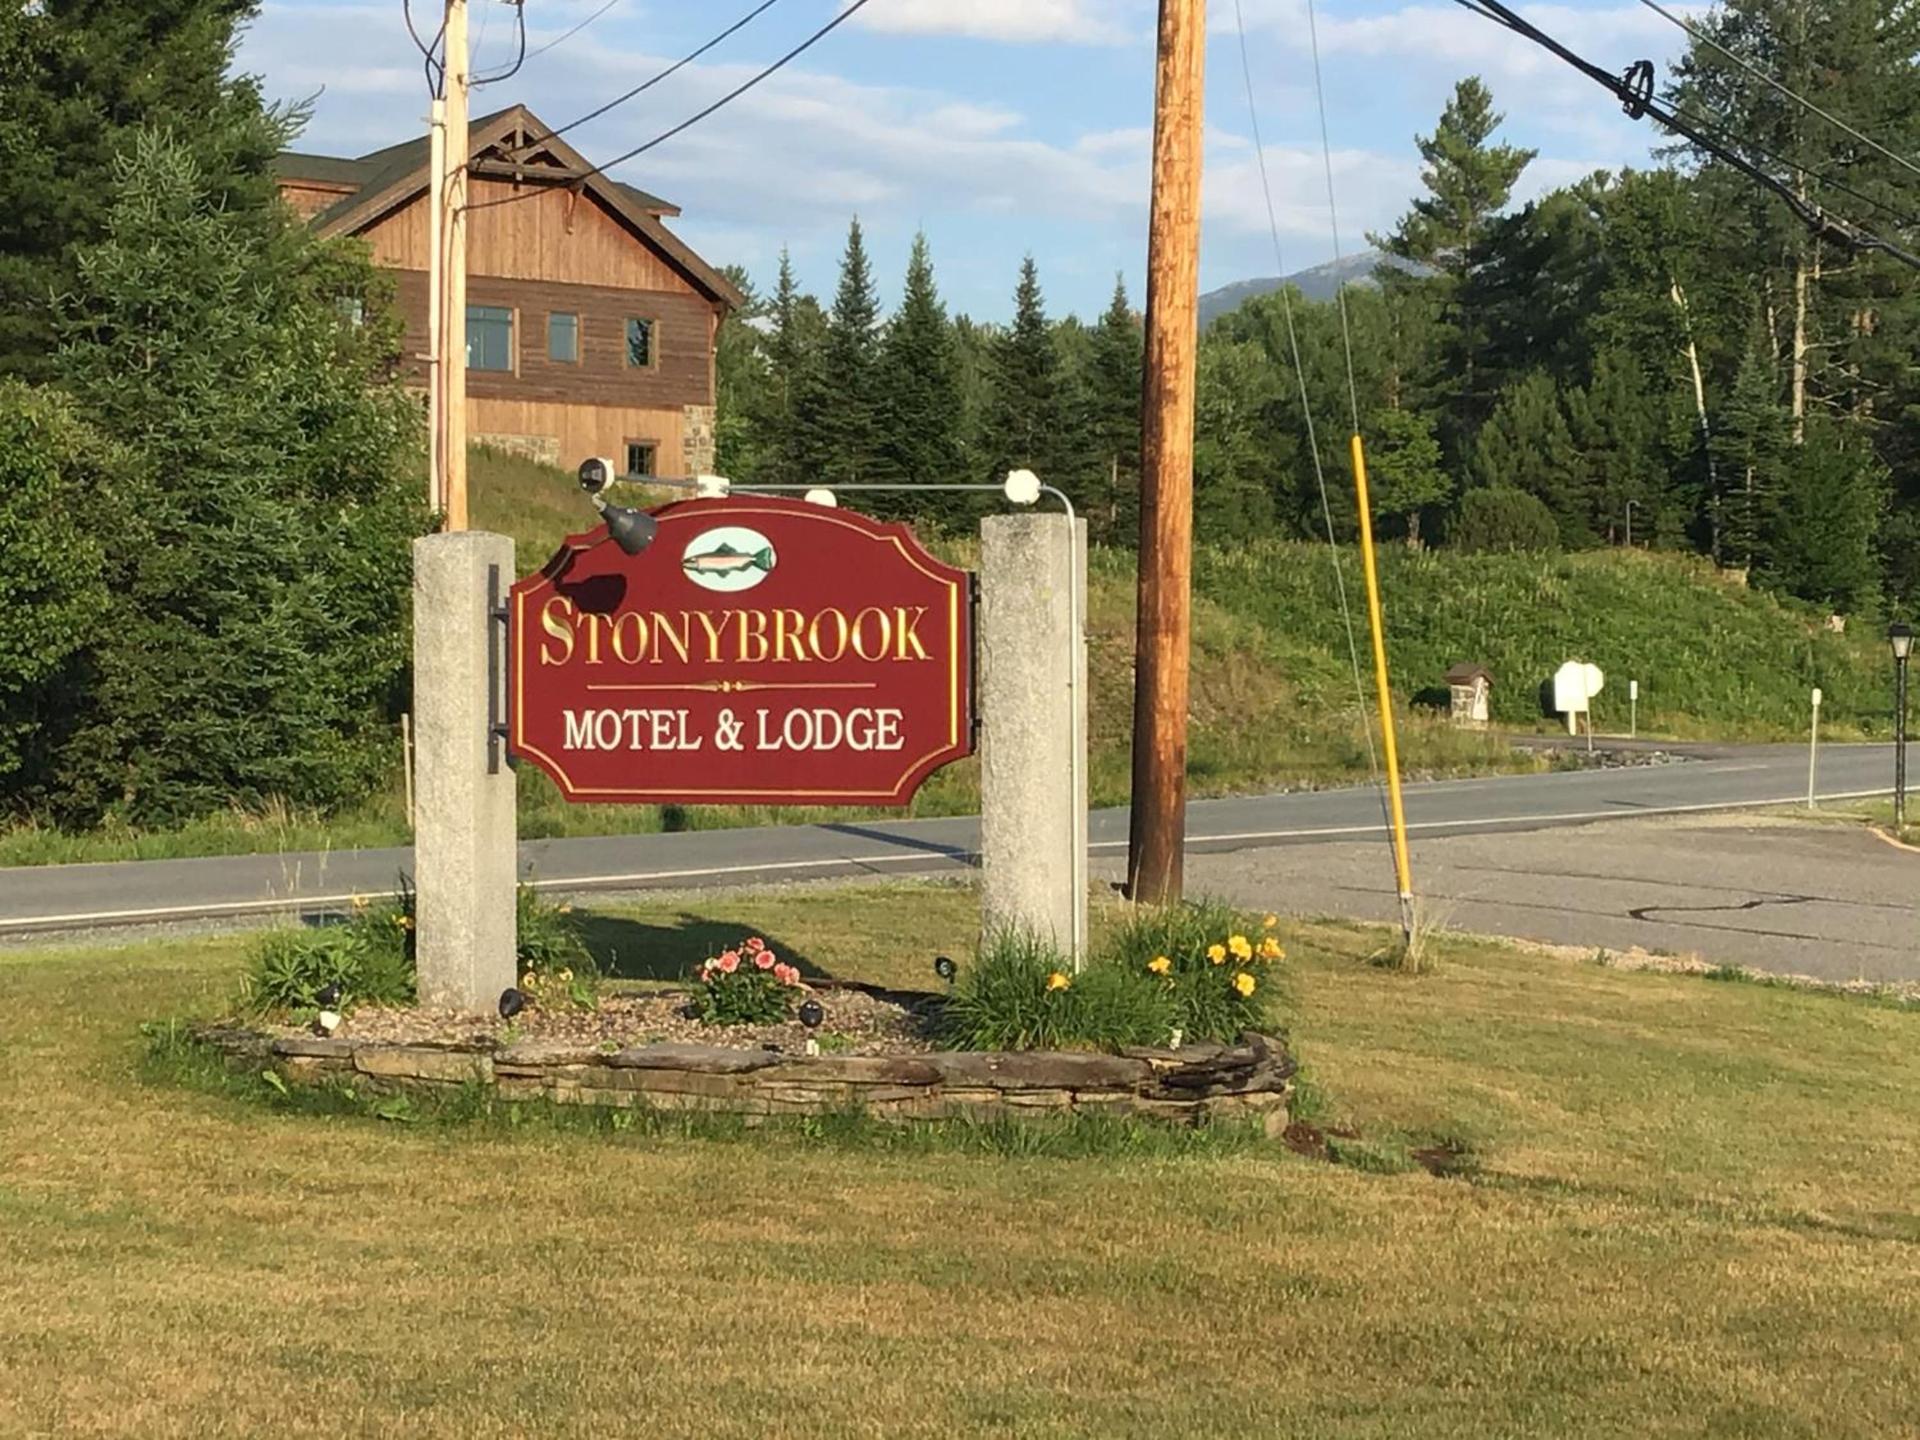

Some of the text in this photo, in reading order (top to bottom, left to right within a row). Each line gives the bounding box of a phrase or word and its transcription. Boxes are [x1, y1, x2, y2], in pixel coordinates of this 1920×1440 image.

[541, 596, 933, 665] STONYBROOK
[562, 708, 904, 751] MOTEL & LODGE
